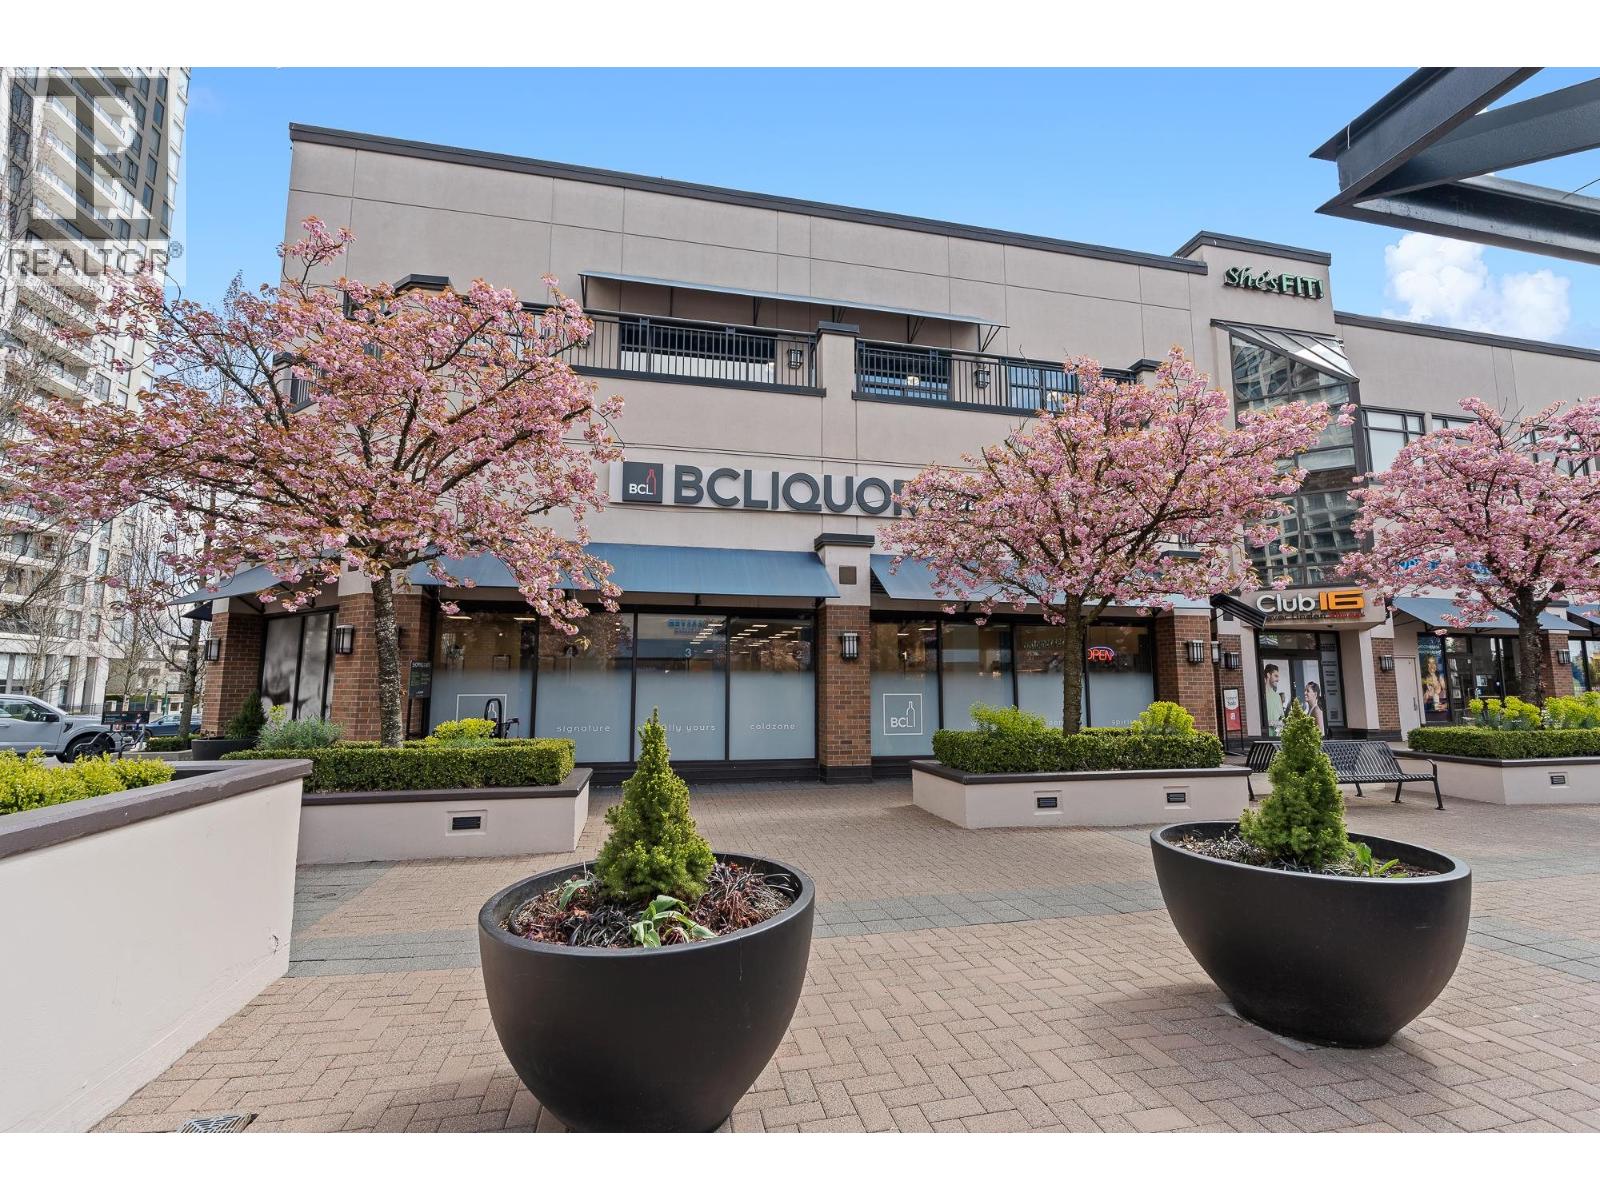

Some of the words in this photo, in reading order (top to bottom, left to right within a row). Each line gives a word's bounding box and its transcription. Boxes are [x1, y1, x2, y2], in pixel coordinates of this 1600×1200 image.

[629, 483, 654, 495] BCL
[1256, 592, 1316, 613] Club
[1318, 590, 1365, 611] 16
[684, 647, 692, 657] 3
[1087, 648, 1113, 661] OPEN
[751, 722, 797, 730] coldzone
[890, 716, 914, 728] BCL
[556, 724, 611, 734] signature
[686, 724, 717, 733] yours
